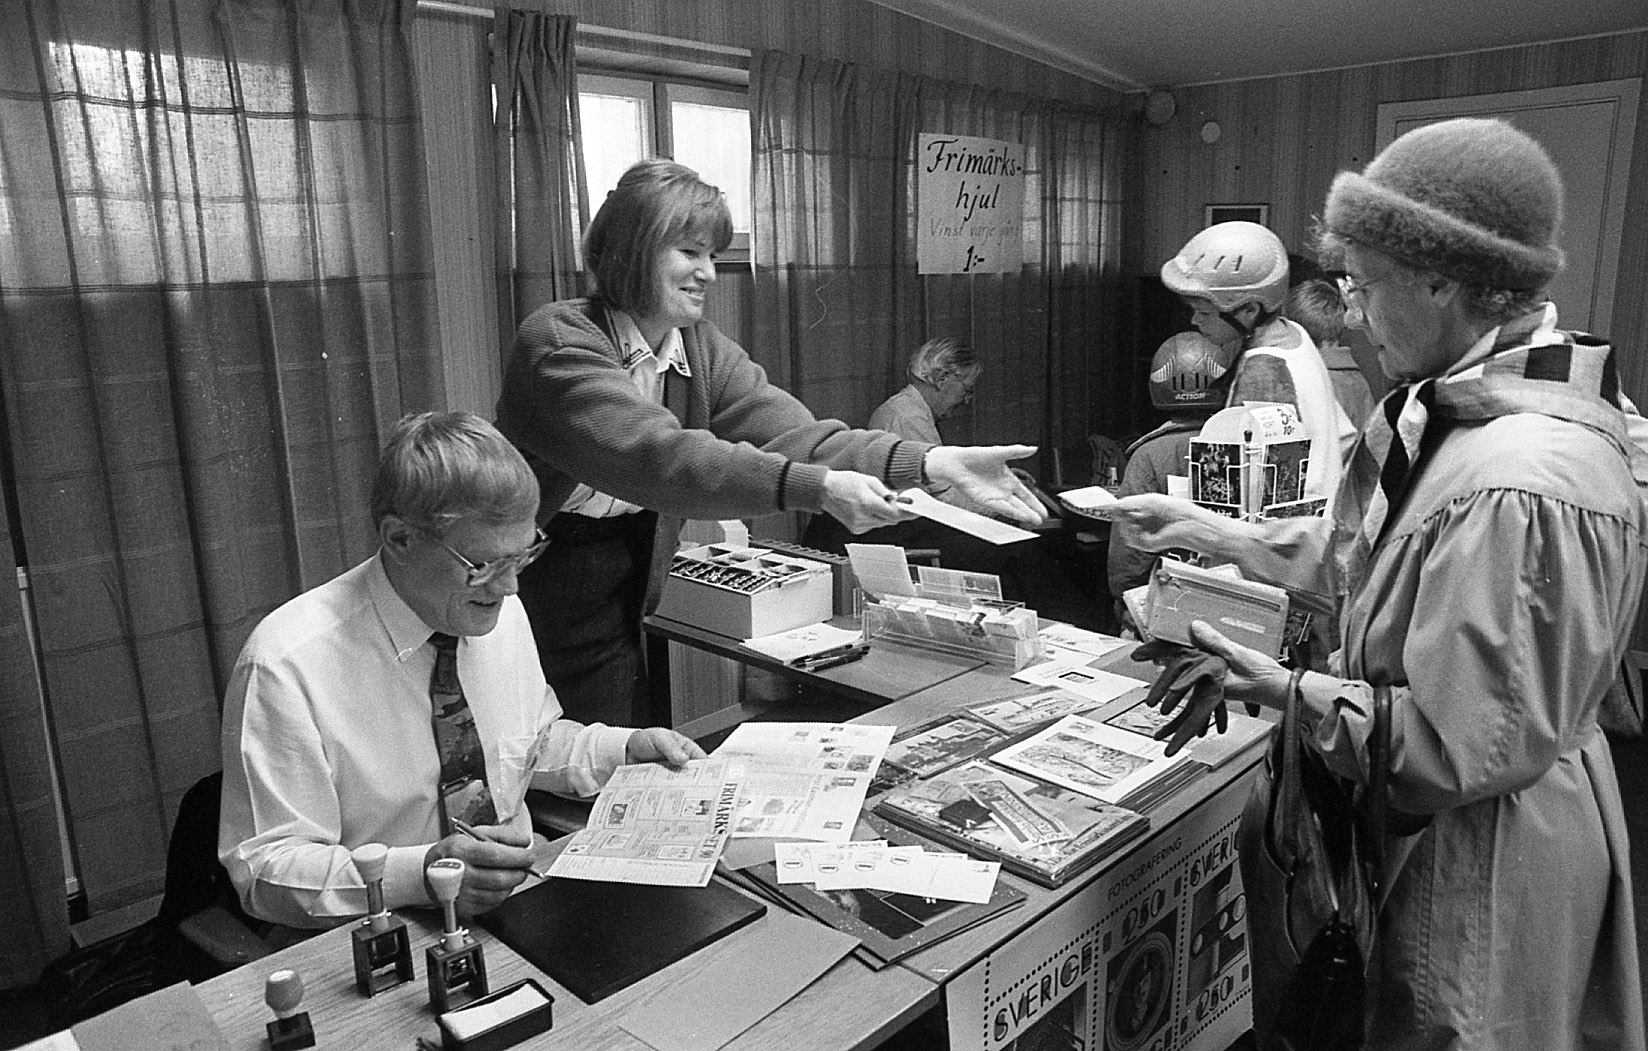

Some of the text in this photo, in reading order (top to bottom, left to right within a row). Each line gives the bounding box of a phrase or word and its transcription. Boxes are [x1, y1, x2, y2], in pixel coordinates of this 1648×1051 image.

[955, 180, 1000, 221] hjul
[962, 245, 985, 272] 1:-
[1174, 391, 1206, 400] ACTION
[1107, 836, 1183, 901] FOTOGRAFERING
[993, 941, 1093, 1043] SVERIGE
[1195, 976, 1234, 1021] 250
